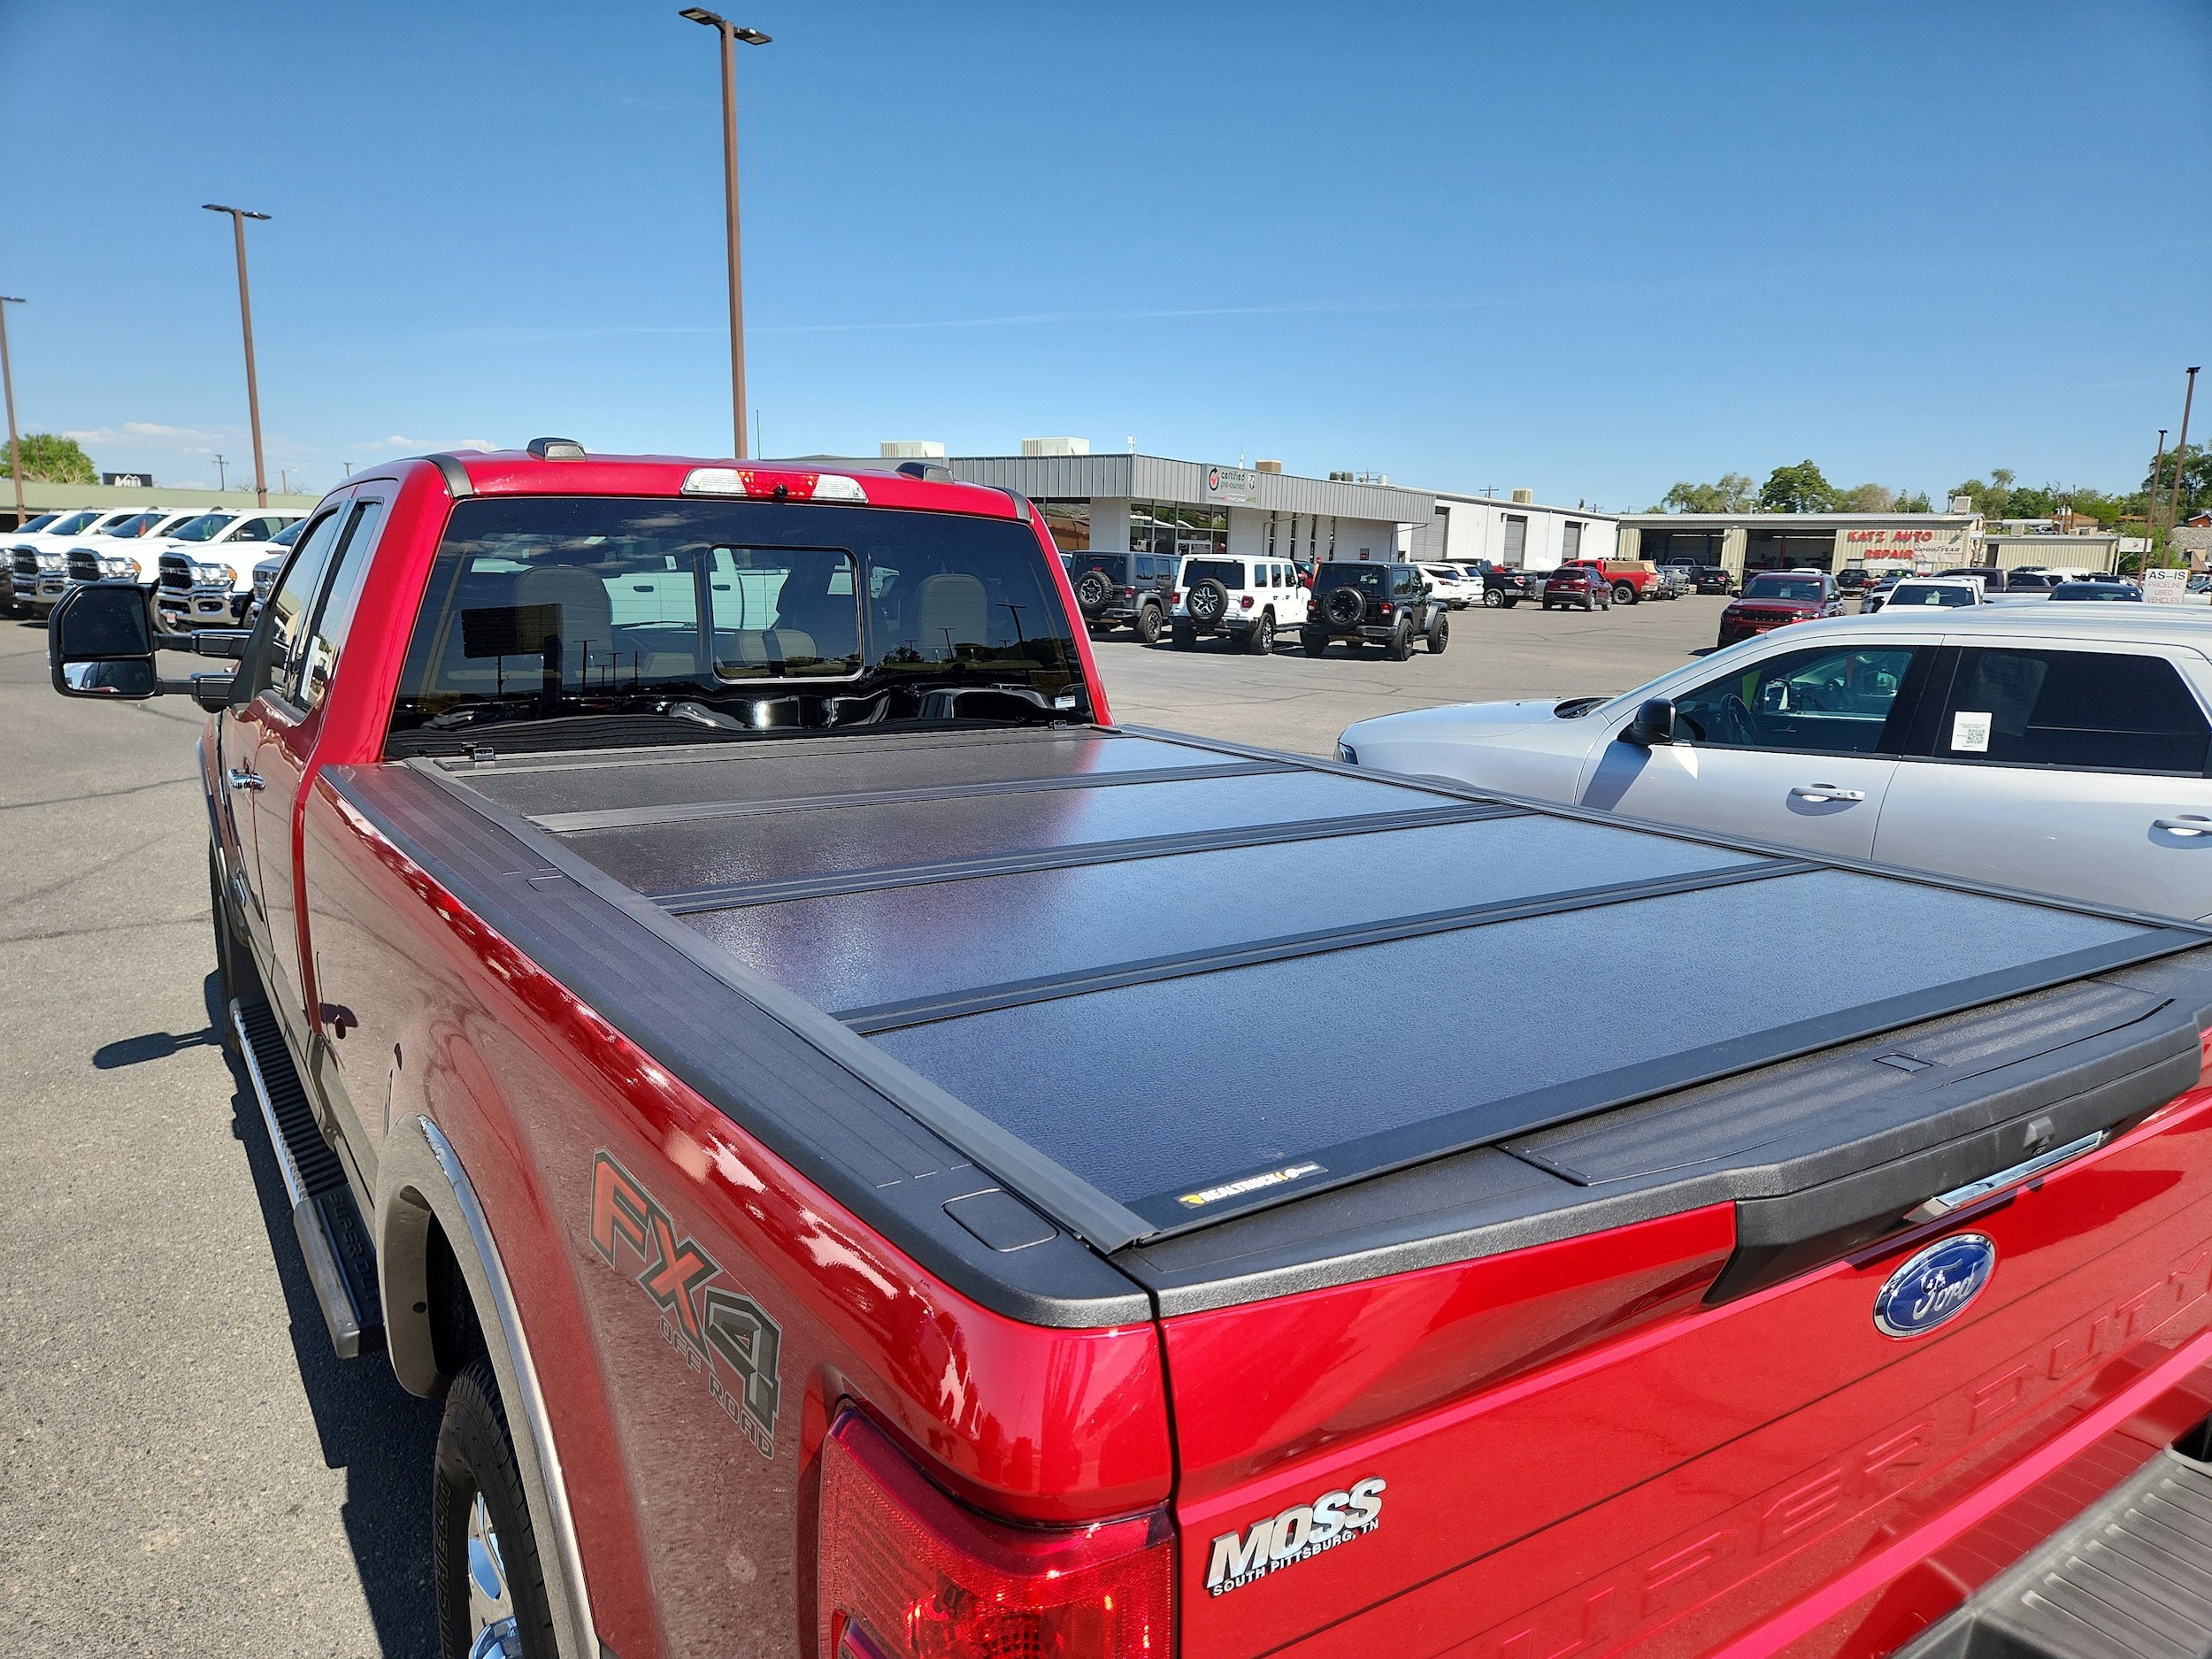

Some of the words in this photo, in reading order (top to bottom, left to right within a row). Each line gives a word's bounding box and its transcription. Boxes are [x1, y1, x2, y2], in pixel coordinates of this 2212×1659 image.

[1847, 531, 1886, 544] KATZ
[1891, 531, 1933, 543] AUTO
[1863, 549, 1914, 560] REPAIR
[589, 1146, 782, 1439] FX4
[1912, 1258, 1978, 1320] Ford
[659, 1315, 703, 1374] OFF
[709, 1373, 774, 1461] ROAD
[1204, 1475, 1386, 1589] MOSS
[1212, 1567, 1265, 1597] SOUTH
[1271, 1531, 1356, 1573] PITTSBURG,
[1361, 1518, 1379, 1536] TN
